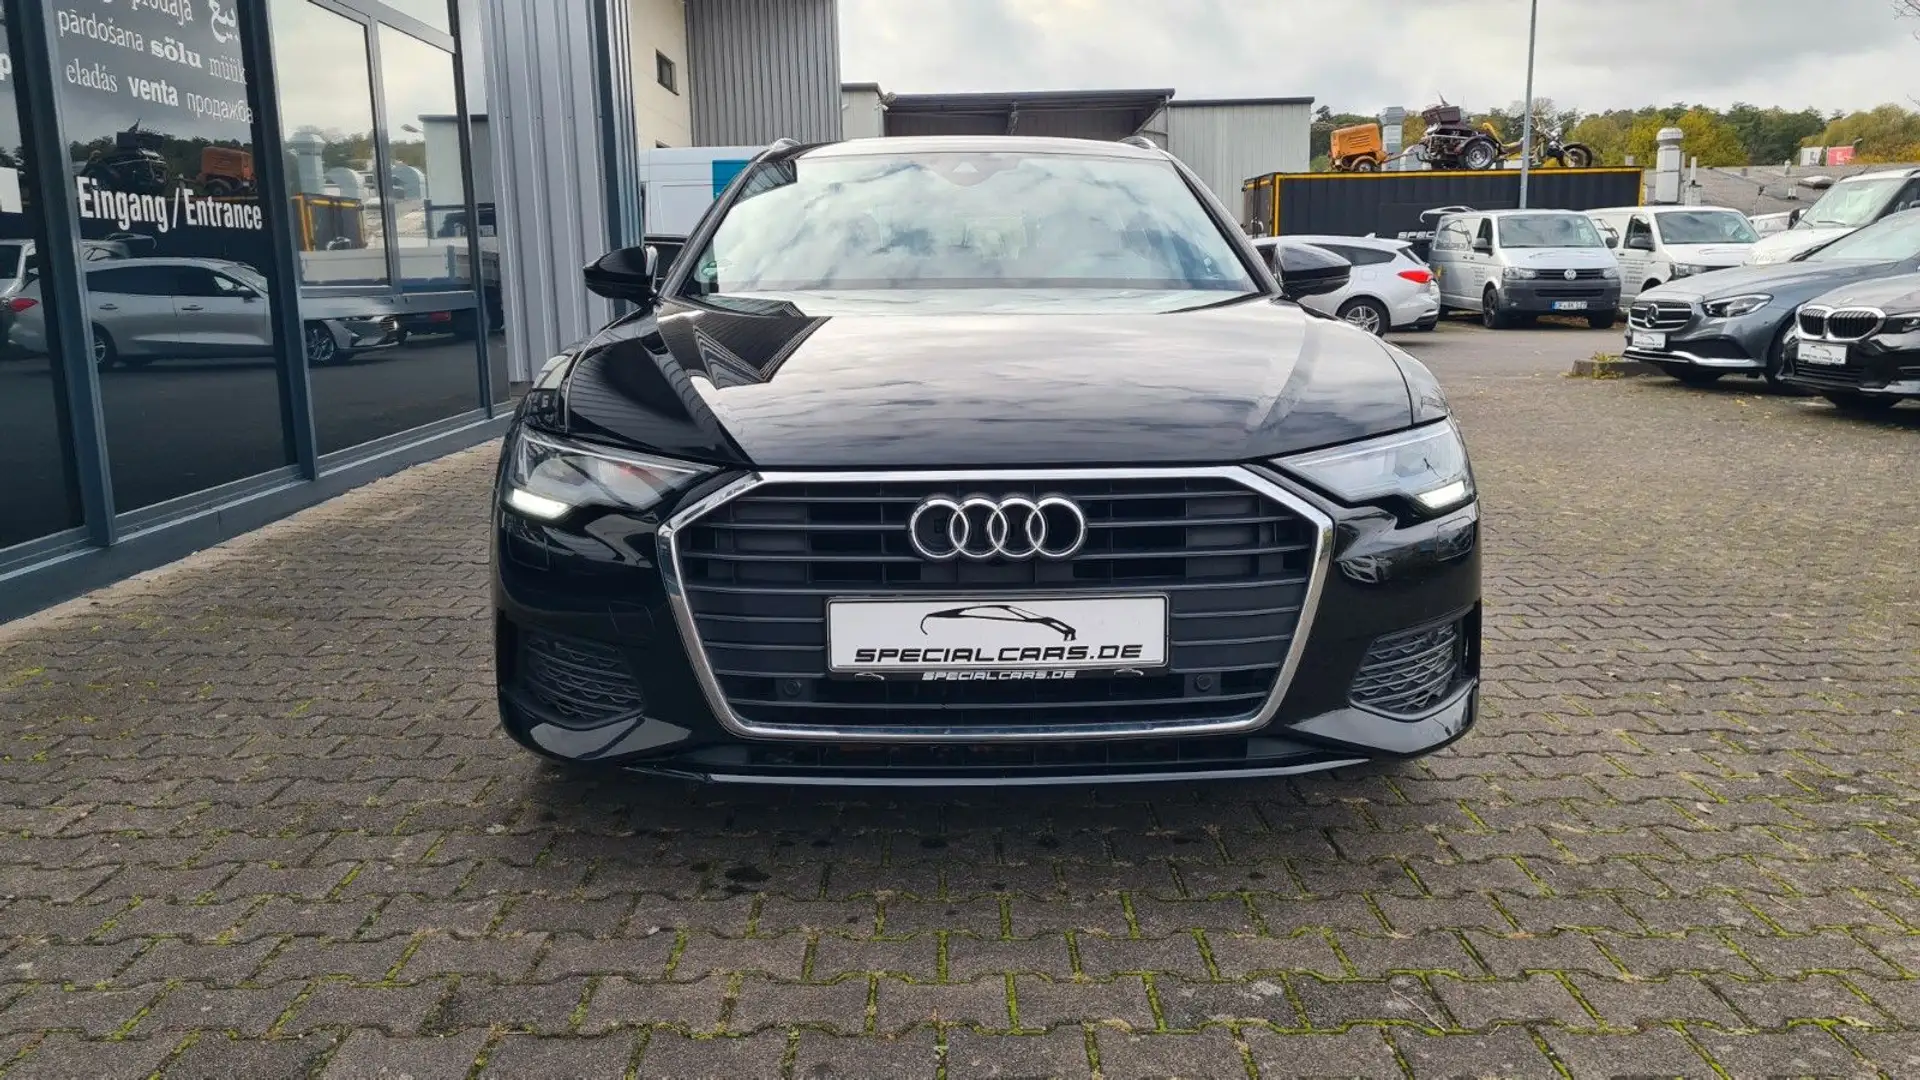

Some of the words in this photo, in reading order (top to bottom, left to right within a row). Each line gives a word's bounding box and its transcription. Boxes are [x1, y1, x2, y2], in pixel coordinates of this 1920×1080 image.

[57, 9, 144, 52] pārdošana
[66, 58, 118, 93] eladás
[128, 76, 179, 107] venta
[187, 92, 254, 124] продажба
[854, 644, 1144, 664] SPECIALCARS.DE
[921, 670, 1078, 681] SPECIALCARS.DE
